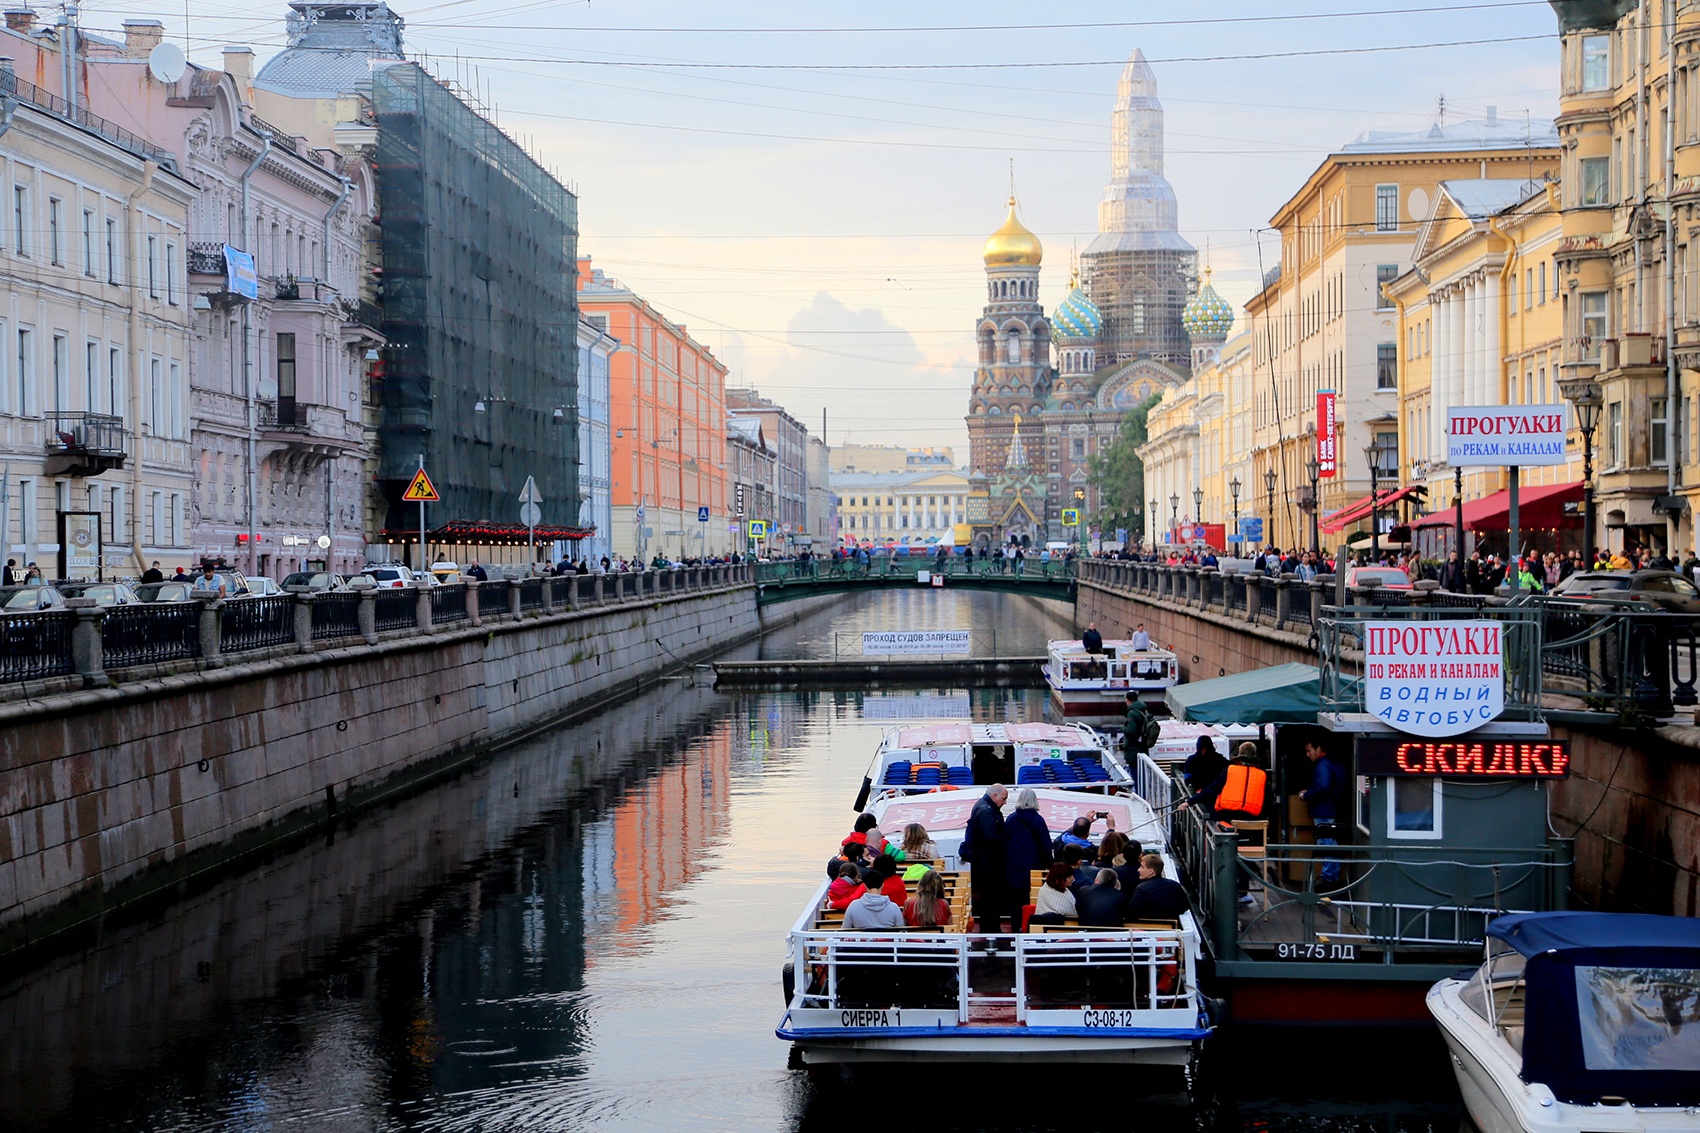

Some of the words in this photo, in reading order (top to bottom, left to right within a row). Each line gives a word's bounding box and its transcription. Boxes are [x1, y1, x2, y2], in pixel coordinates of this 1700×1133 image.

[1450, 415, 1563, 435] ПРОГУЛКИ
[1463, 443, 1500, 456] РЕКАМ
[1507, 442, 1562, 455] КАНАЛАМ
[863, 634, 896, 643] ПРОХОД
[899, 634, 923, 643] СУДОВ
[925, 633, 968, 642] ЗАПРЕЩЕН
[1368, 626, 1500, 656] ПРОГУЛКИ
[1369, 664, 1384, 679] ПО
[1388, 664, 1426, 679] РЕКАМ
[1430, 664, 1437, 679] И
[1440, 663, 1499, 678] КАНАЛАМ
[1379, 684, 1490, 704] ВОДНЫЙ
[1379, 705, 1491, 725] АВТОБУС
[1278, 943, 1325, 959] 91-75
[1329, 944, 1355, 960] ЛД
[841, 1010, 889, 1027] СИЕРРА
[895, 1010, 901, 1027] 1
